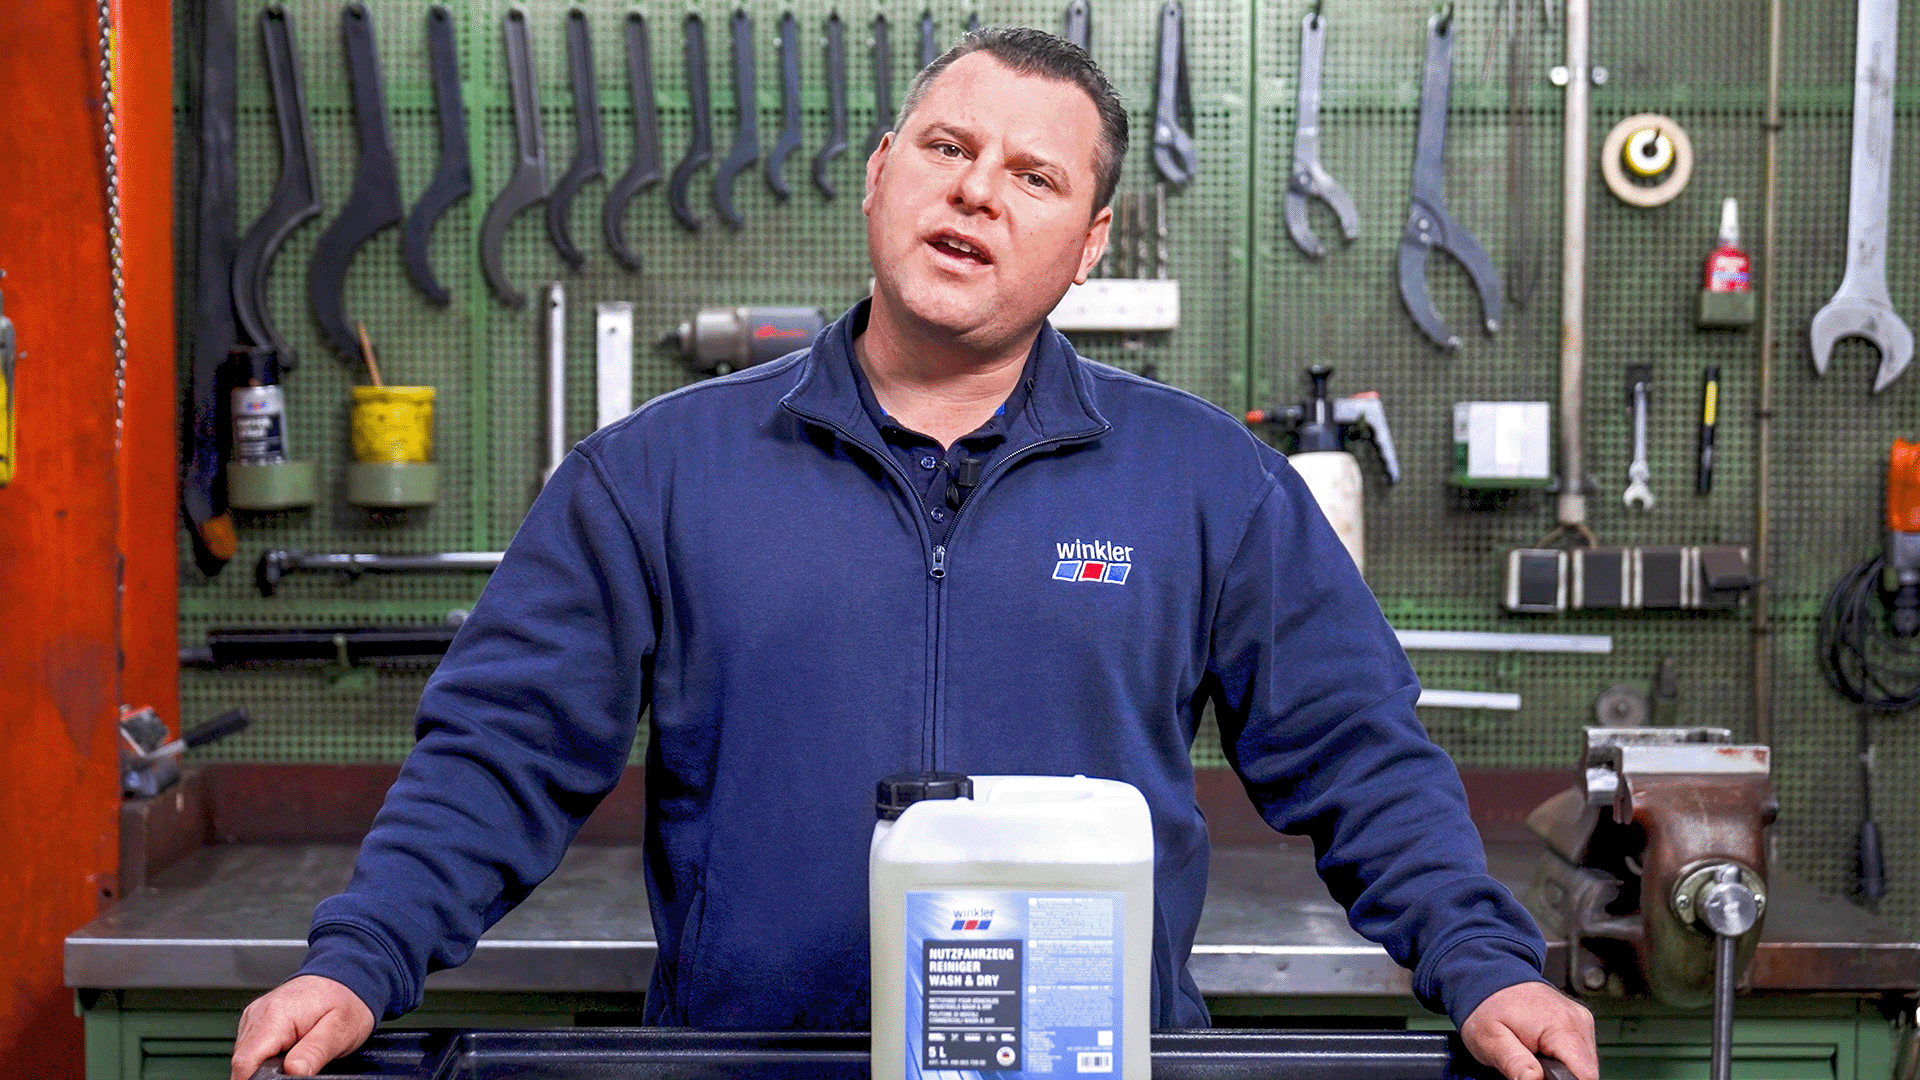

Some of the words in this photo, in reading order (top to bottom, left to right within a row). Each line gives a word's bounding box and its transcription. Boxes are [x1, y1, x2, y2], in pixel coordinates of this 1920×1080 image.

[1056, 538, 1134, 562] winkler
[953, 907, 995, 918] winkler
[929, 948, 1014, 960] NUTZFAHRZEUG
[929, 961, 981, 973] REINIGER
[929, 974, 962, 987] WASH
[964, 974, 974, 987] &
[976, 974, 999, 987] DRY
[928, 1046, 936, 1058] 5
[939, 1046, 947, 1058] L
